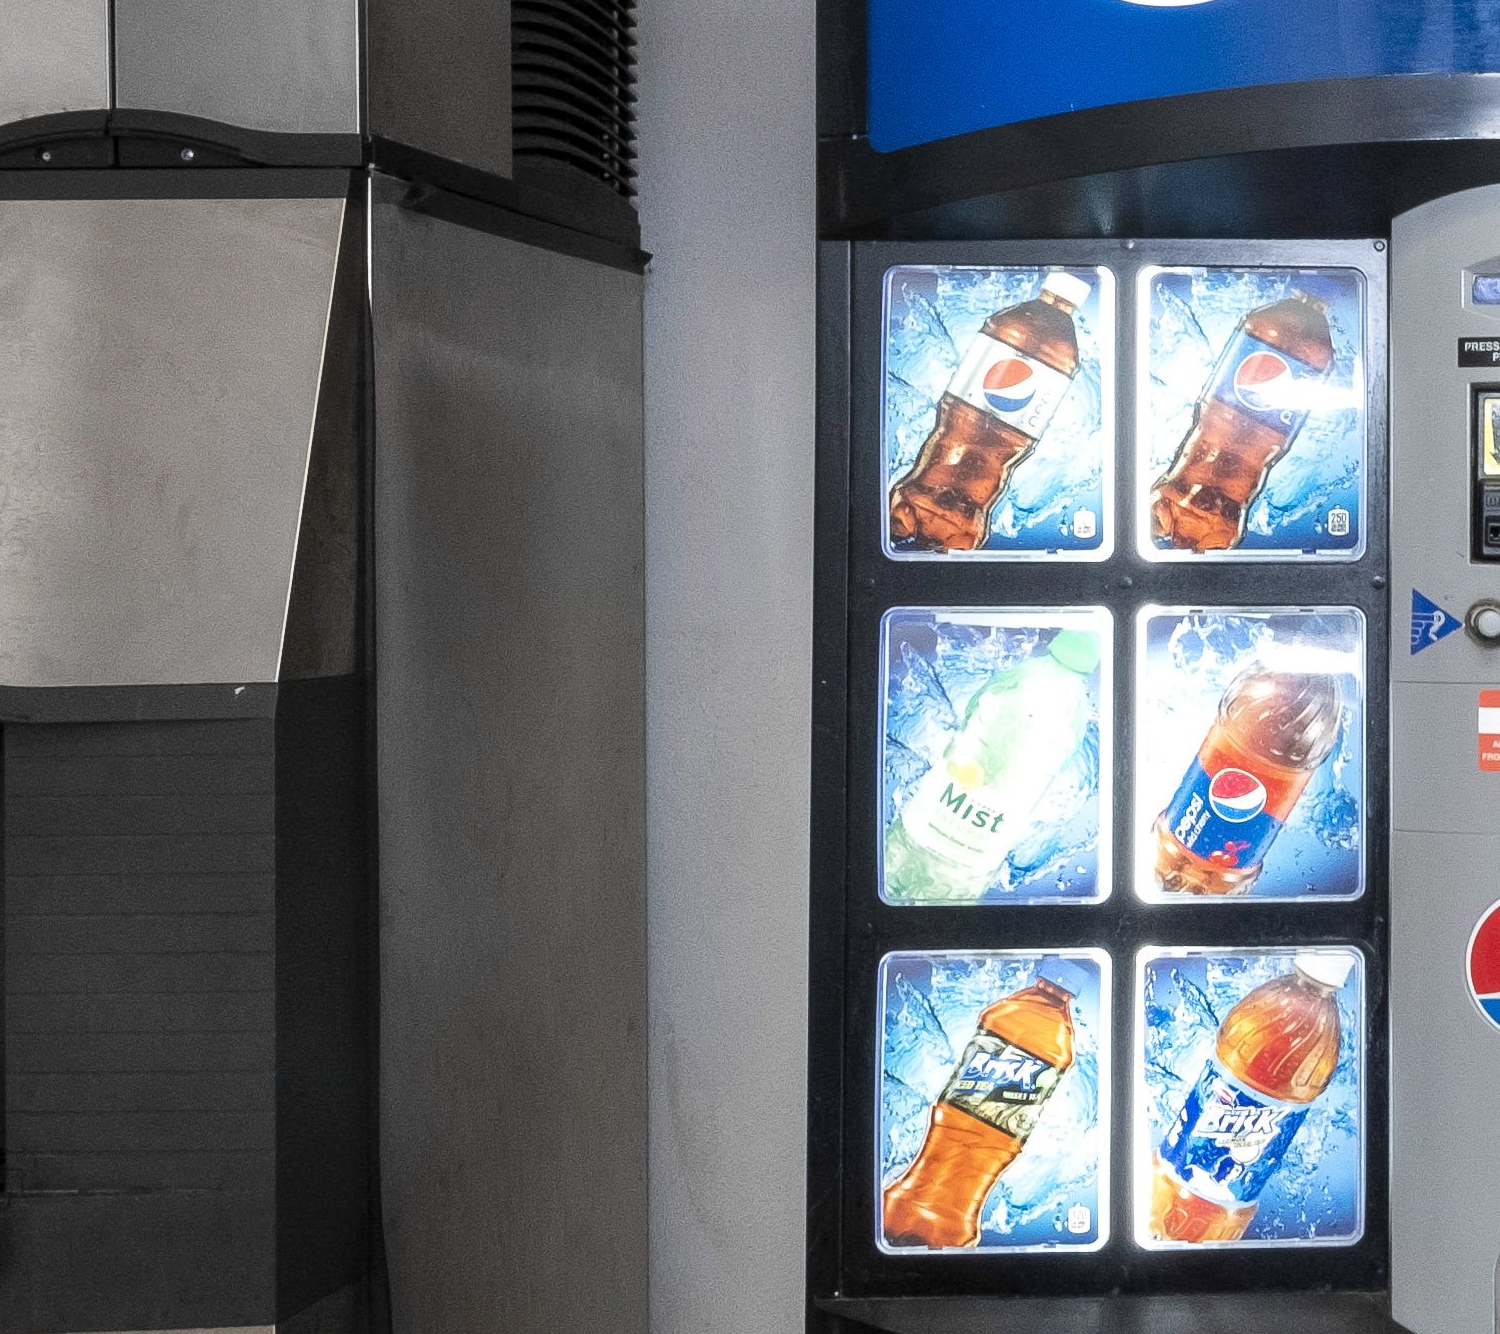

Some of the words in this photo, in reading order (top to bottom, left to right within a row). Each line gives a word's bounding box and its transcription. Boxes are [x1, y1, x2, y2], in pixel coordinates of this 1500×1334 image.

[1464, 341, 1500, 353] PRESS
[938, 781, 1006, 835] Mist
[1174, 791, 1204, 846] pepsi
